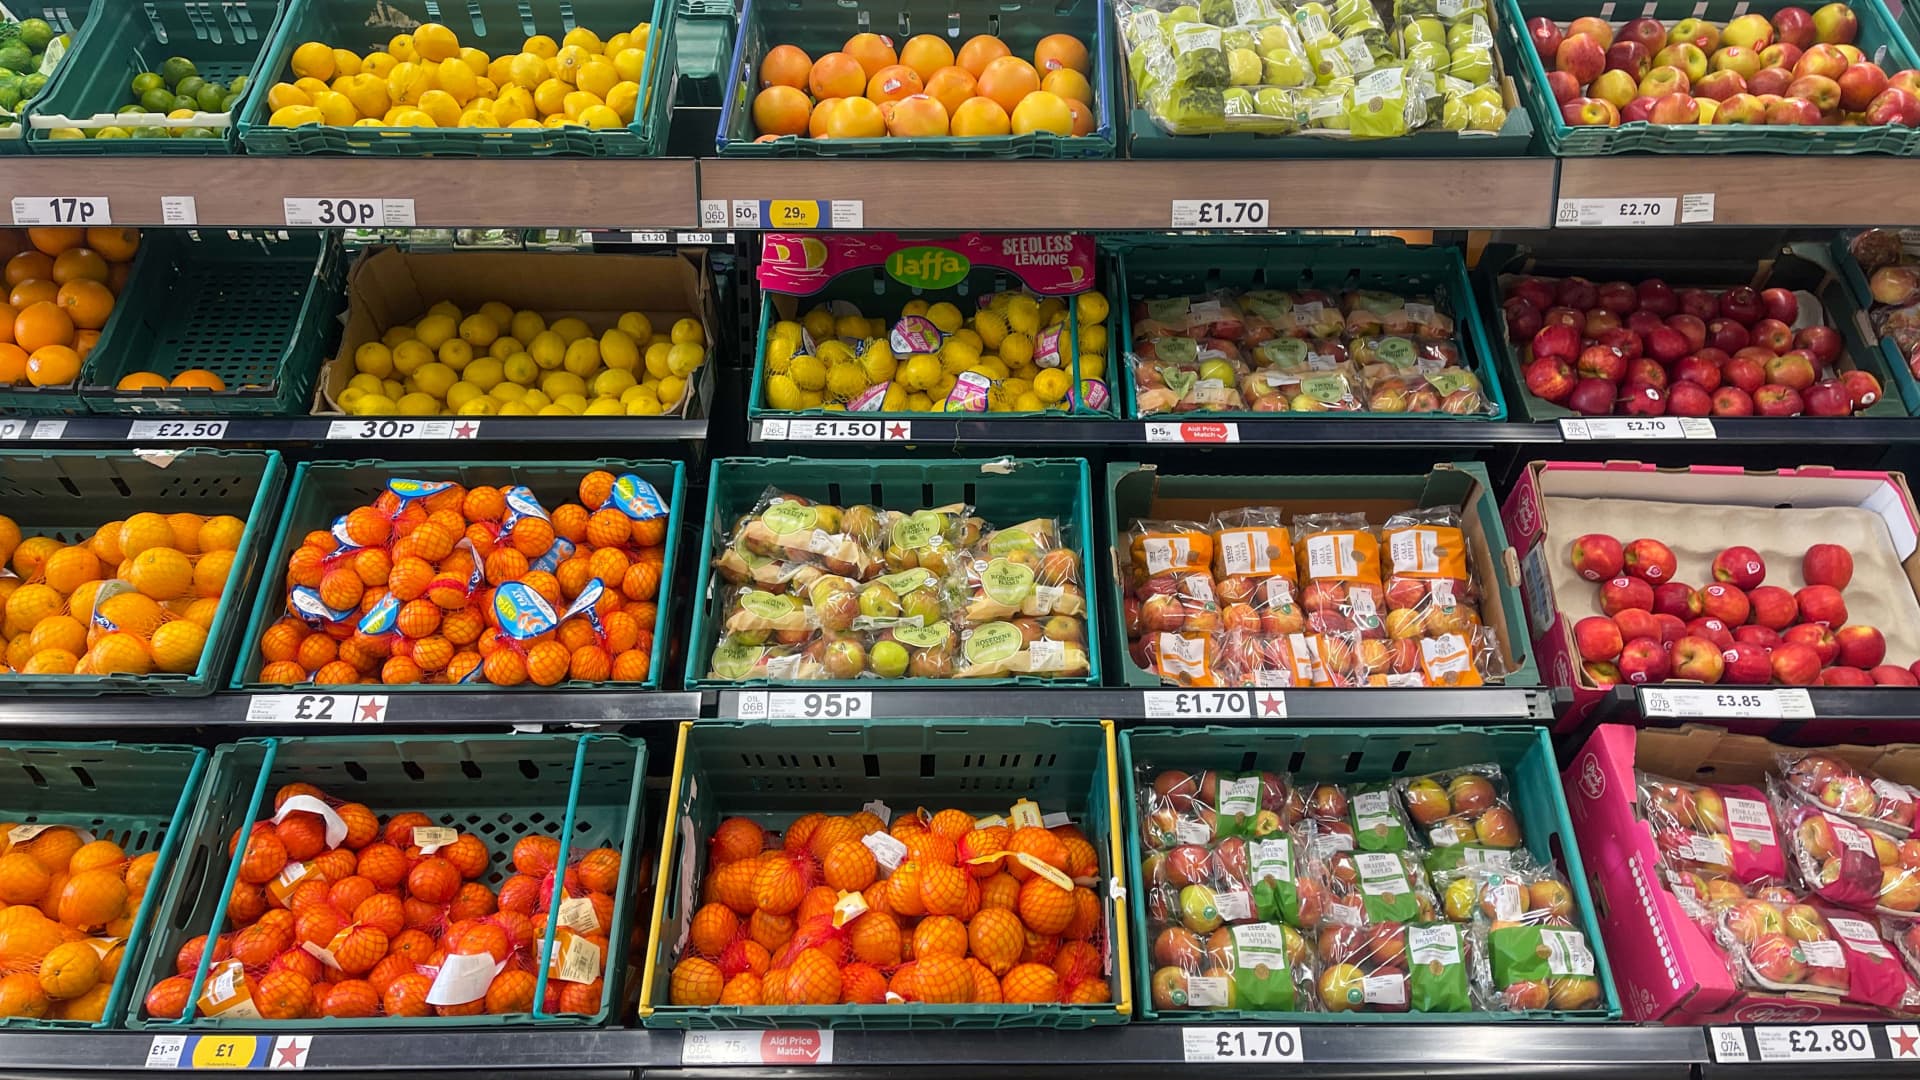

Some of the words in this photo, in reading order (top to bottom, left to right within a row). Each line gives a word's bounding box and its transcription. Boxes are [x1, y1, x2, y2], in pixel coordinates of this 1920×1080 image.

[50, 199, 94, 223] 17p
[318, 200, 374, 224] 30p
[705, 211, 725, 220] 06D
[735, 208, 757, 220] 50p
[784, 207, 805, 220] 29p
[1199, 202, 1264, 223] £1.70
[1560, 210, 1578, 219] 07D
[1619, 203, 1661, 216] £2.70
[641, 233, 665, 242] £1.20
[687, 233, 711, 242] £1.20
[1002, 235, 1073, 255] SEEDLESS
[1015, 253, 1068, 266] LEMONS
[156, 423, 222, 436] £2.50
[360, 421, 415, 438] 30p
[815, 423, 876, 436] £1.50
[1151, 427, 1171, 436] 95p
[1627, 421, 1666, 431] £2.70
[975, 632, 1012, 648] ROSEDENE
[294, 695, 335, 720] £2
[742, 703, 763, 711] 06B
[804, 693, 861, 717] 95p
[1175, 693, 1244, 713] £1.70
[1650, 700, 1670, 709] 07B
[1716, 695, 1761, 708] £3.85
[770, 1036, 787, 1046] Aldi
[789, 1036, 813, 1046] Price
[1216, 1031, 1295, 1057] £1.70
[1721, 1042, 1741, 1052] 07A
[1789, 1029, 1866, 1053] £2.80
[151, 1045, 180, 1056] £1.30
[215, 1044, 235, 1057] £1
[777, 1046, 805, 1057] Match
